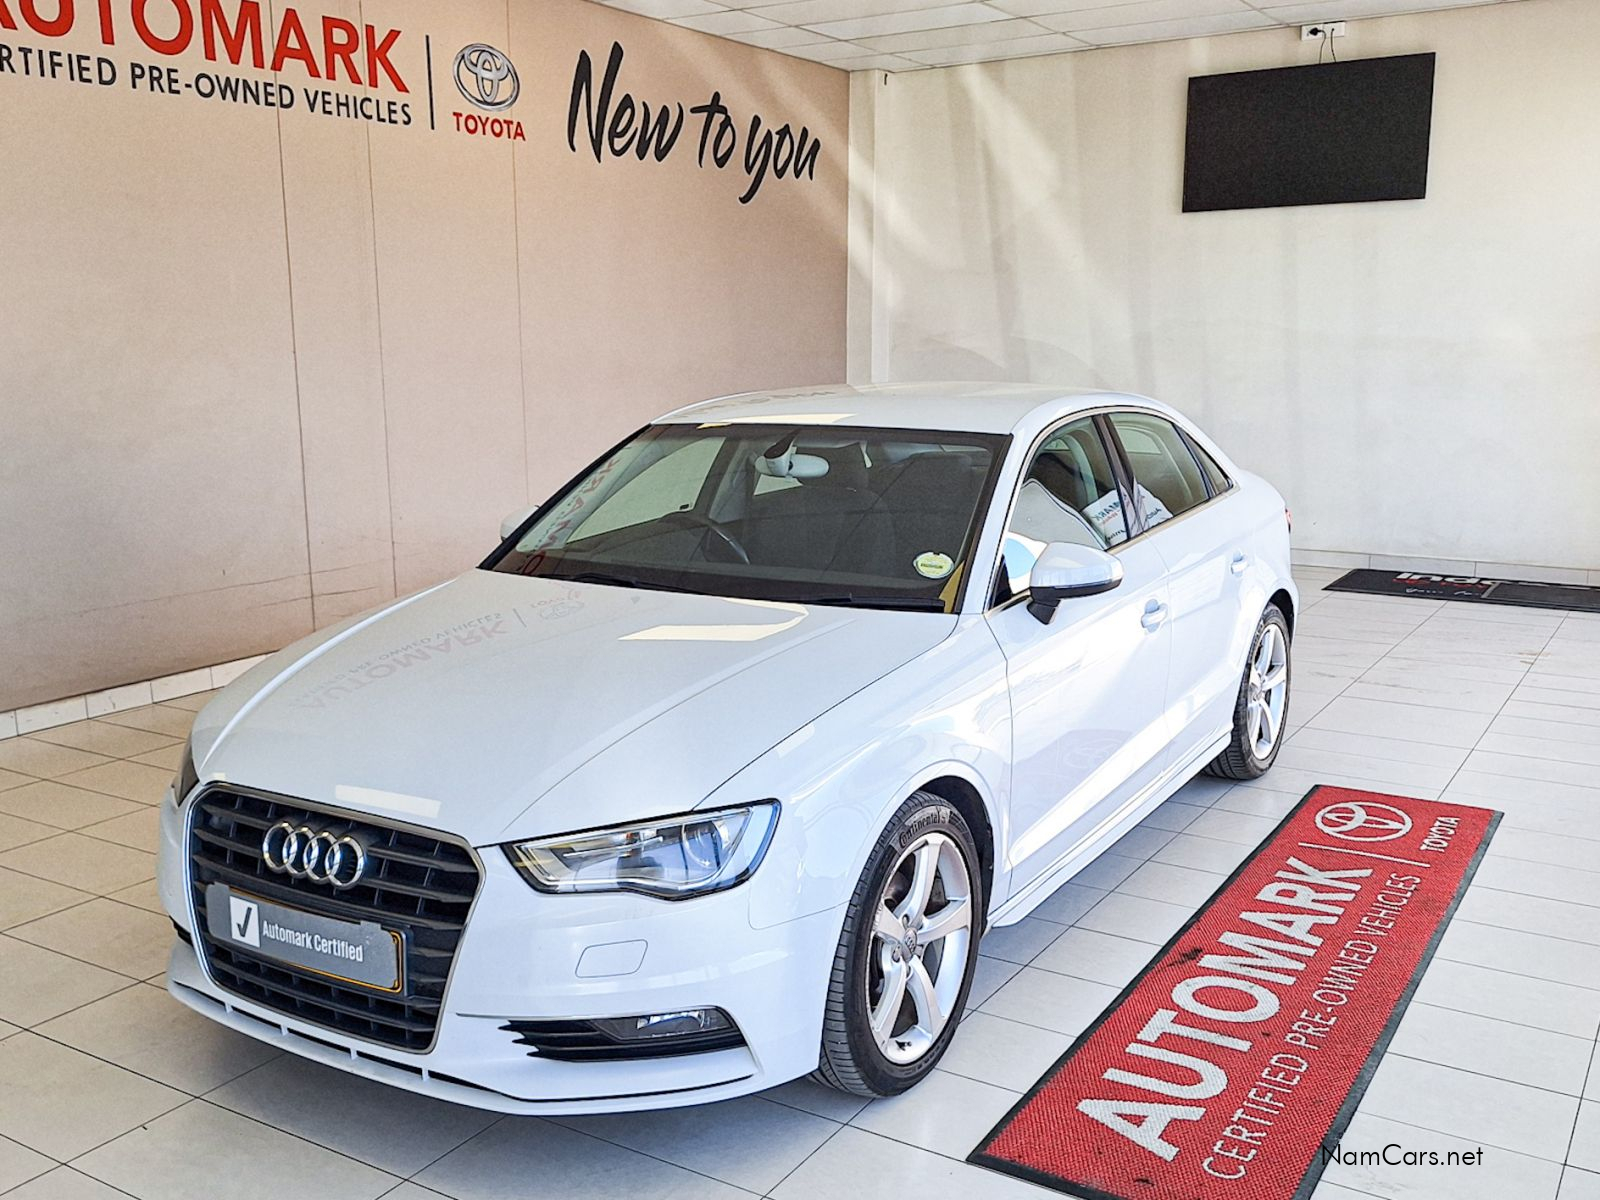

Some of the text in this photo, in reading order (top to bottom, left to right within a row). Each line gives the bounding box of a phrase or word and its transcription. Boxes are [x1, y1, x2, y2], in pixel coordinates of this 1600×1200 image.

[130, 62, 295, 109] PRE-OWNED
[304, 88, 412, 126] VEHICLES
[452, 111, 526, 141] TOYOTA
[567, 40, 821, 204] New to you
[1420, 815, 1461, 852] TOYOTA
[262, 919, 364, 963] Automark Certified
[1075, 856, 1374, 1162] AUTOMARK
[1202, 872, 1422, 1180] CERTIFIED PRE-OWNED VEHICLES
